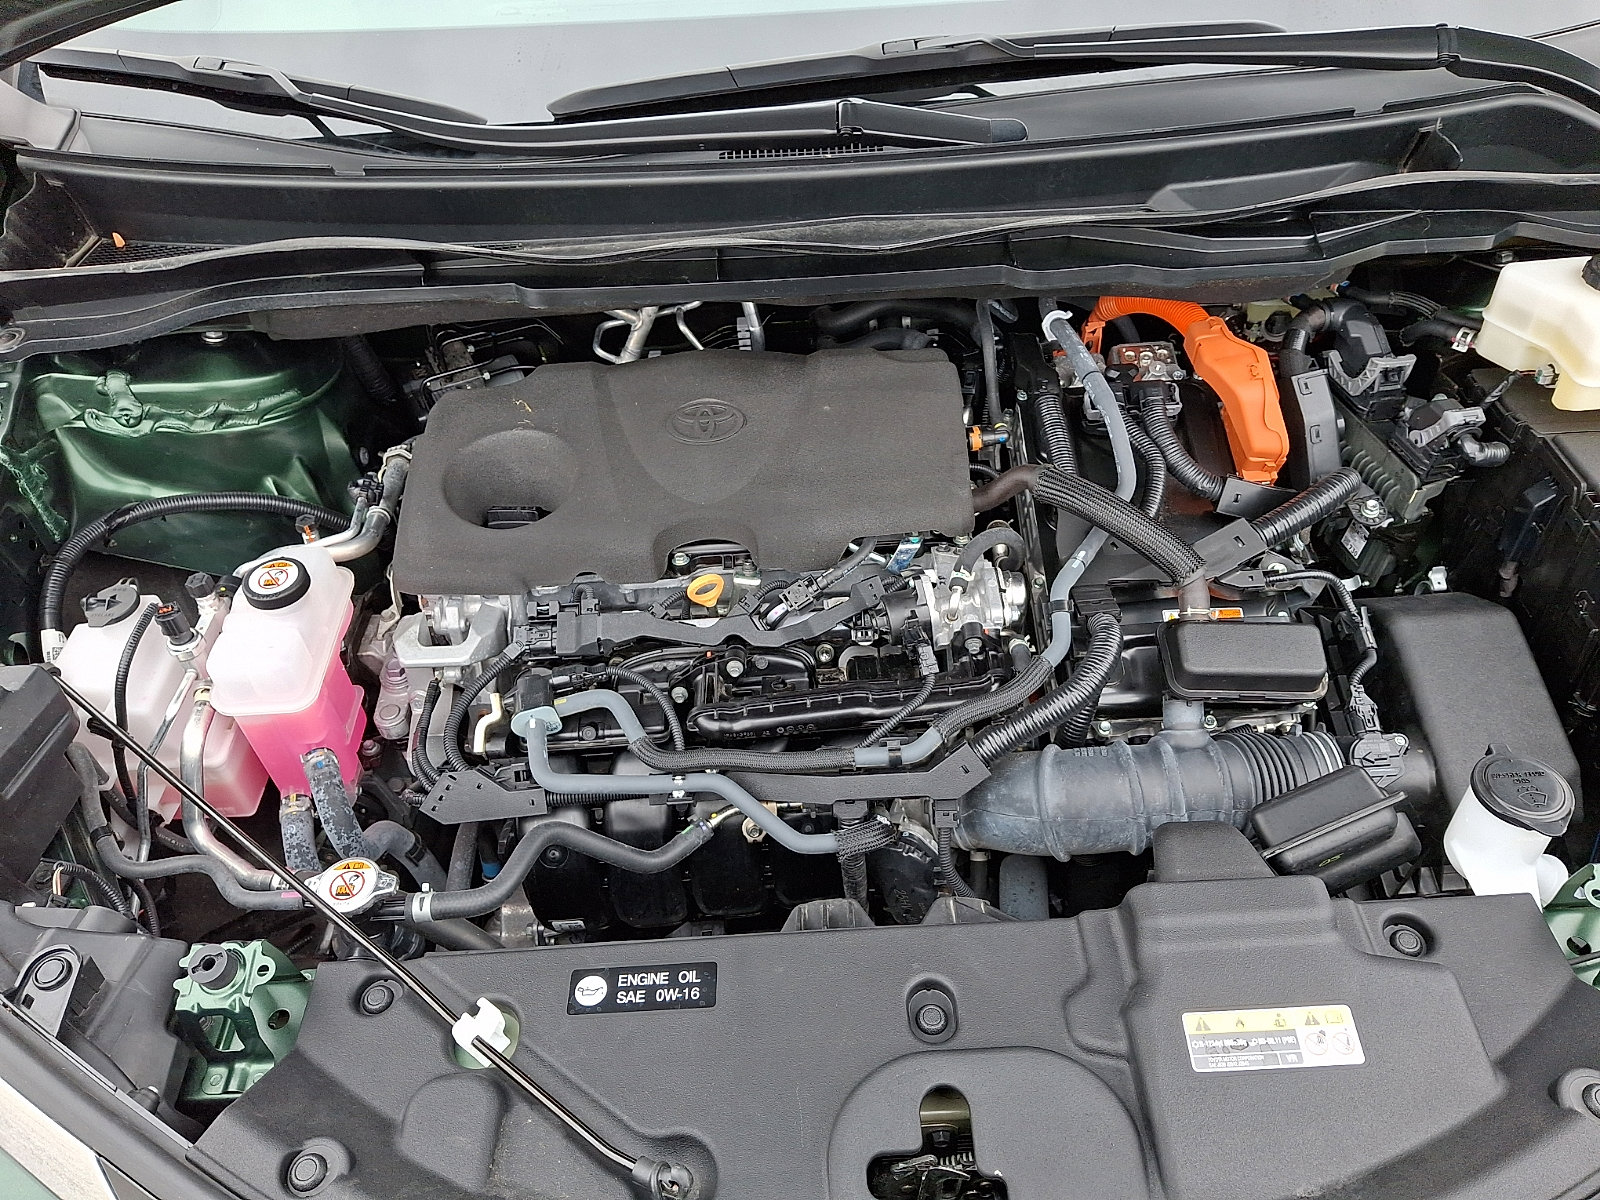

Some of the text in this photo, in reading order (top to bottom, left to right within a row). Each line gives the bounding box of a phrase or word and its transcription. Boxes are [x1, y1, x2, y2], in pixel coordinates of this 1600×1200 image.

[618, 971, 701, 987] ENGINE OIL
[616, 987, 700, 1003] SAE 0W-16
